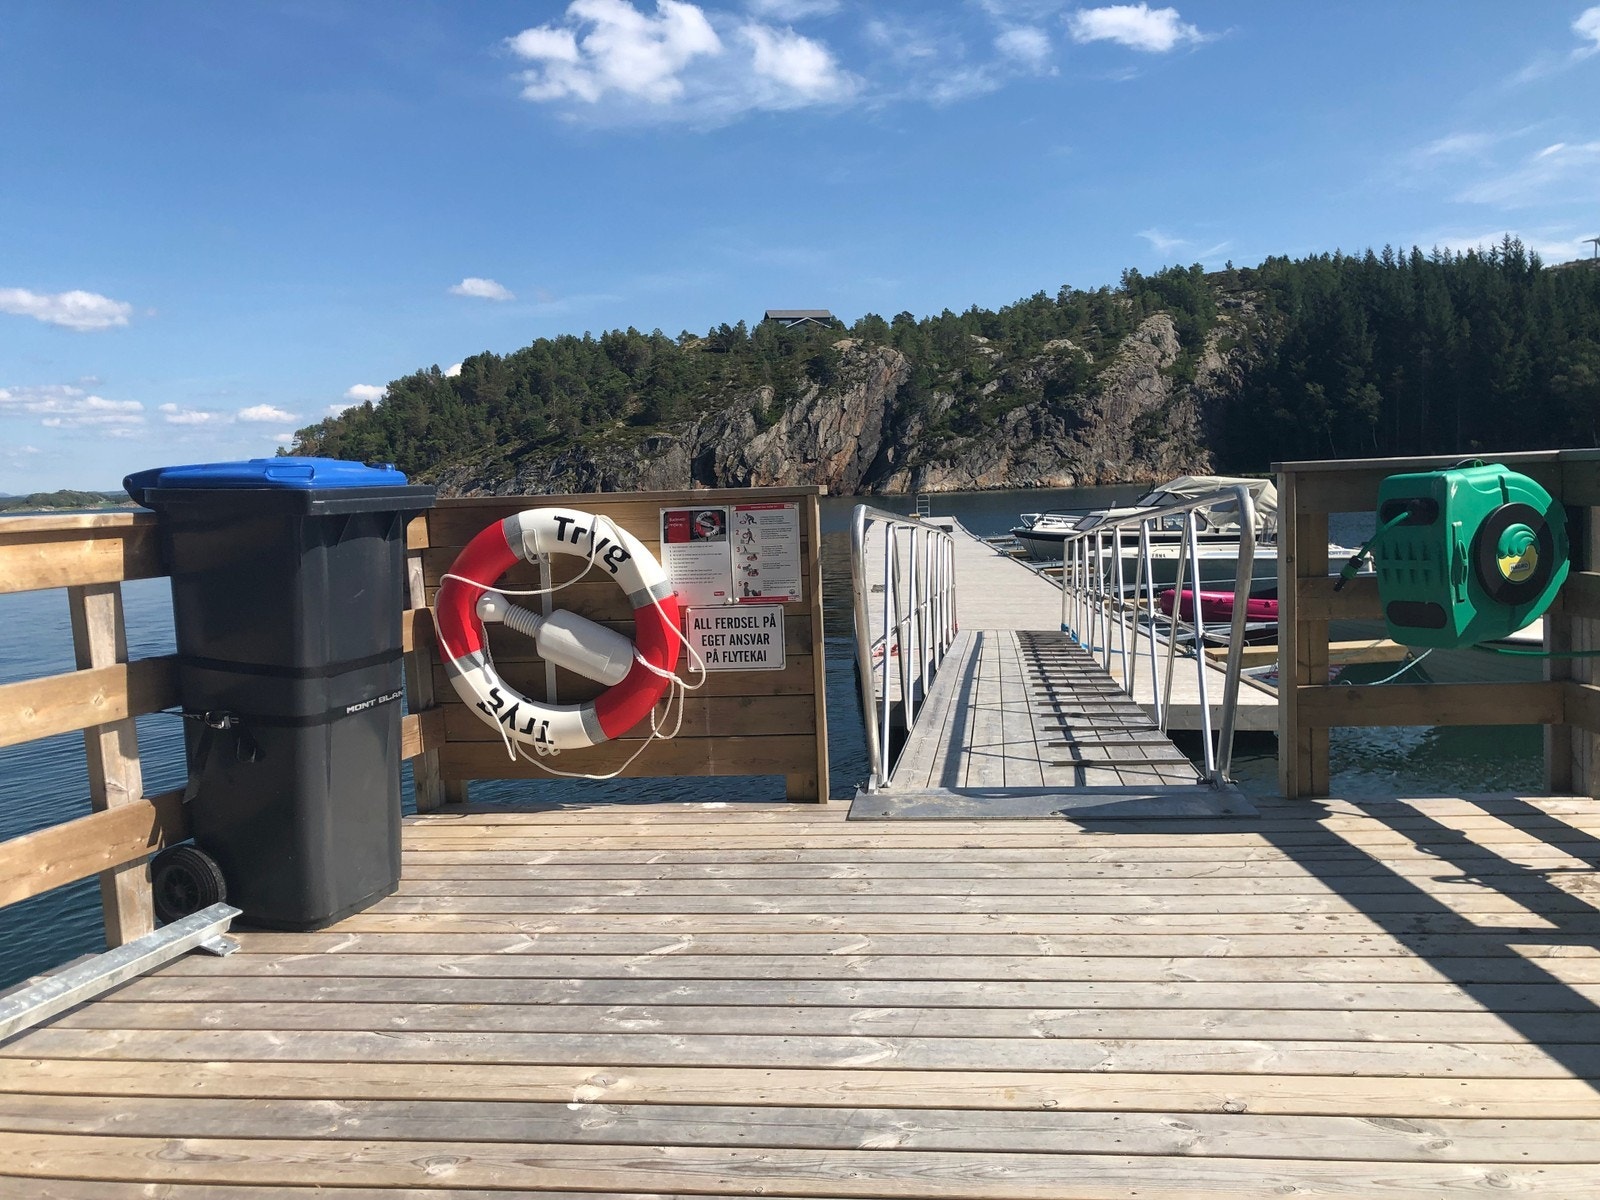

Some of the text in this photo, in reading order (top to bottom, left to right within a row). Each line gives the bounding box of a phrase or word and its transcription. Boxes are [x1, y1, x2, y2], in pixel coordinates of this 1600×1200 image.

[553, 515, 632, 574] Tryg
[694, 612, 776, 630] ALL FERDSEL PÅ
[702, 632, 770, 647] EGET ANSVAR
[705, 648, 767, 663] PÅ FLYTEKAI
[346, 698, 377, 714] MONT
[476, 687, 554, 745] Tryg
